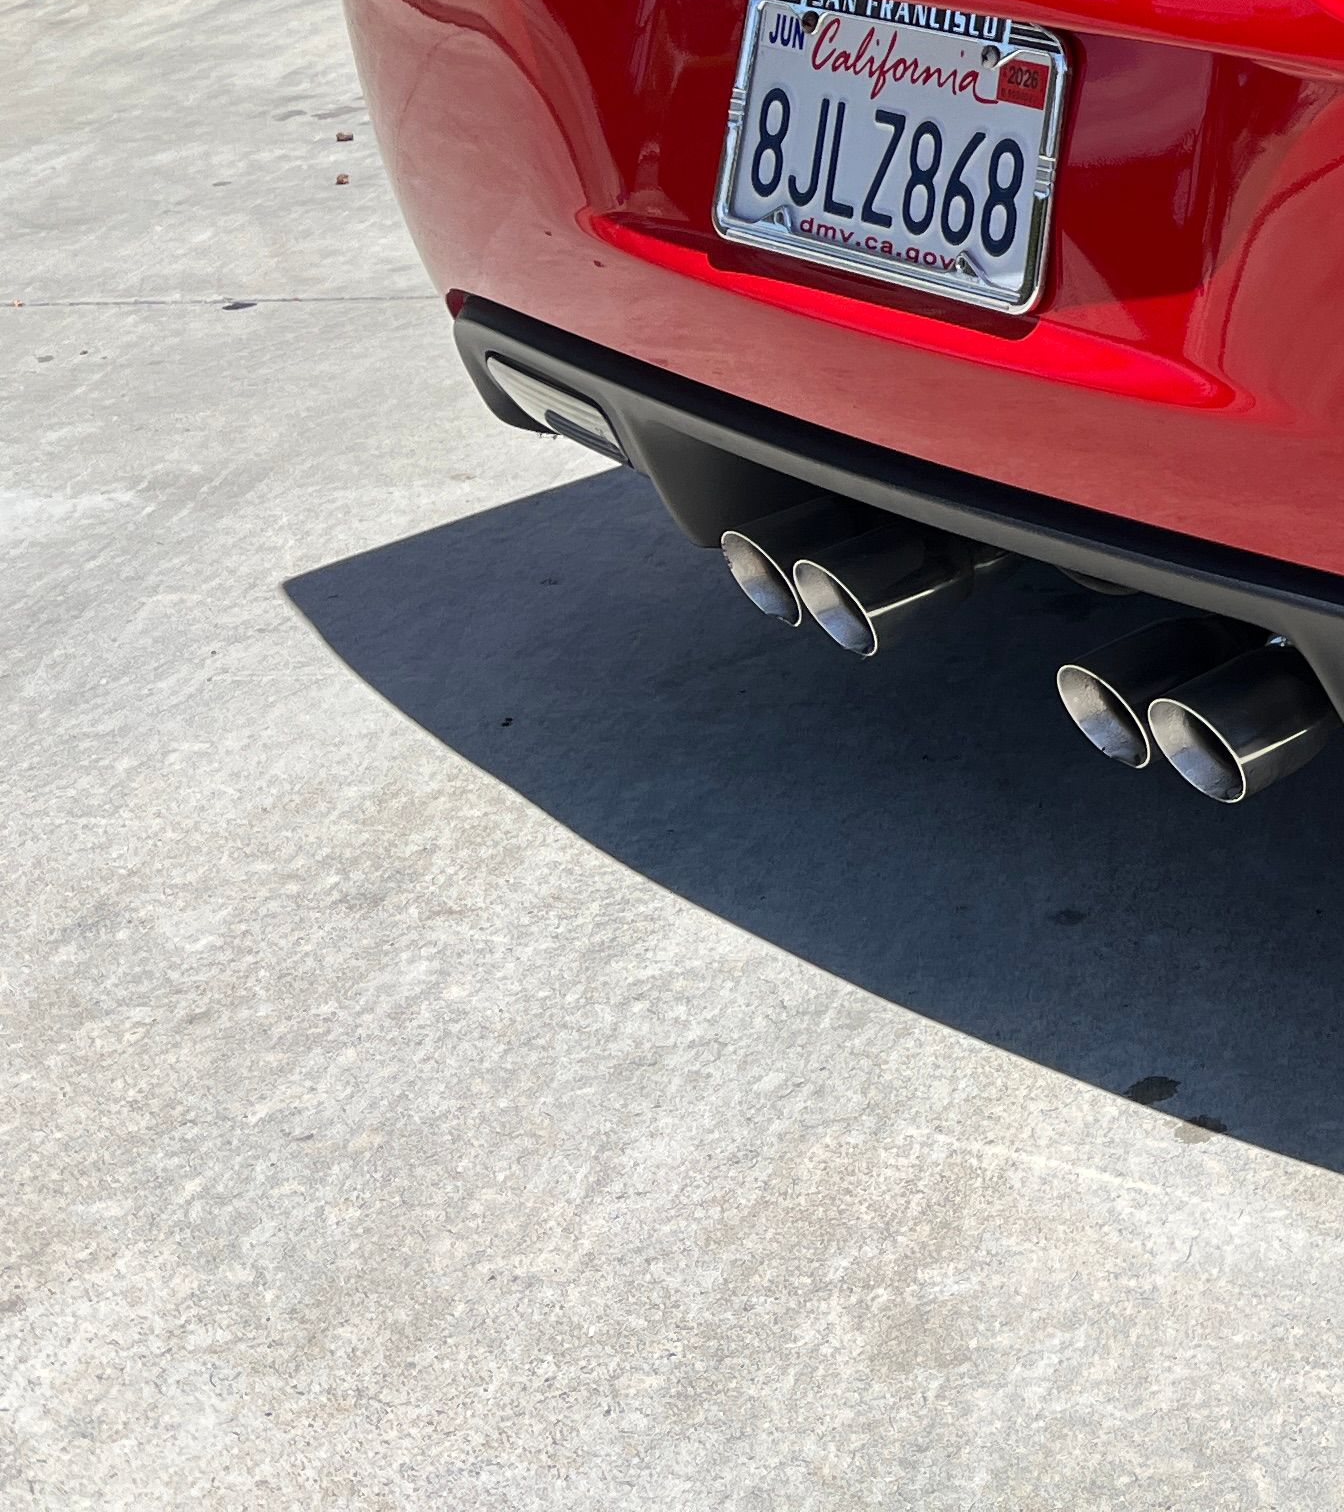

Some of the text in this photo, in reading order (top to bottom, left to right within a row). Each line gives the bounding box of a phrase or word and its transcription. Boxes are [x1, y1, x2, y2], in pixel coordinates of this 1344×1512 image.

[768, 13, 805, 51] JUN
[811, 18, 999, 104] California
[1007, 65, 1039, 89] 2026
[751, 87, 1024, 258] 8JLZ868
[799, 216, 956, 271] dmv.ca.gov
